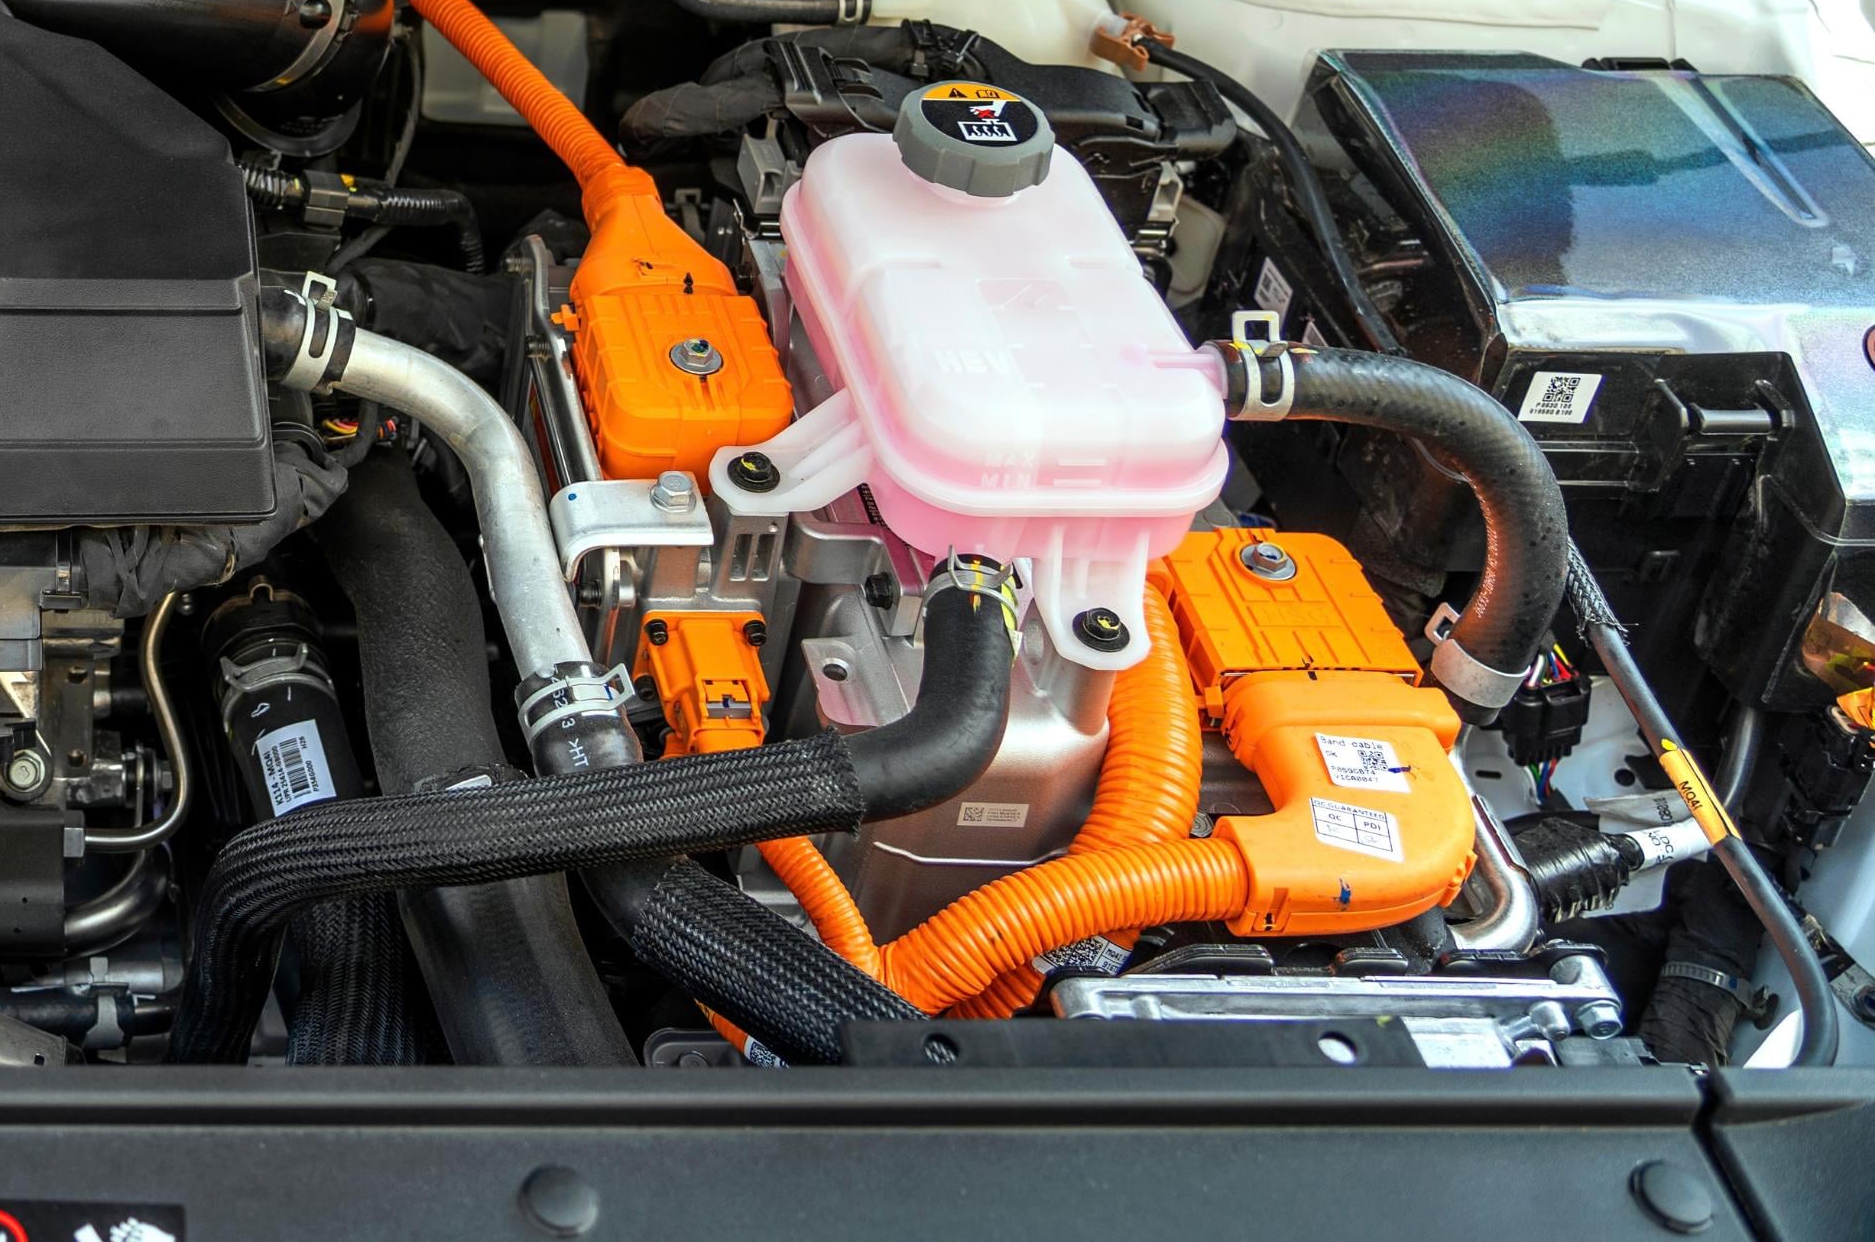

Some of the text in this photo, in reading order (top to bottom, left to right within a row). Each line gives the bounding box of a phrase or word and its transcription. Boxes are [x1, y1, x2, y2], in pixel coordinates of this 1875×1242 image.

[271, 781, 285, 806] K114
[1328, 813, 1382, 831] QC PDI
